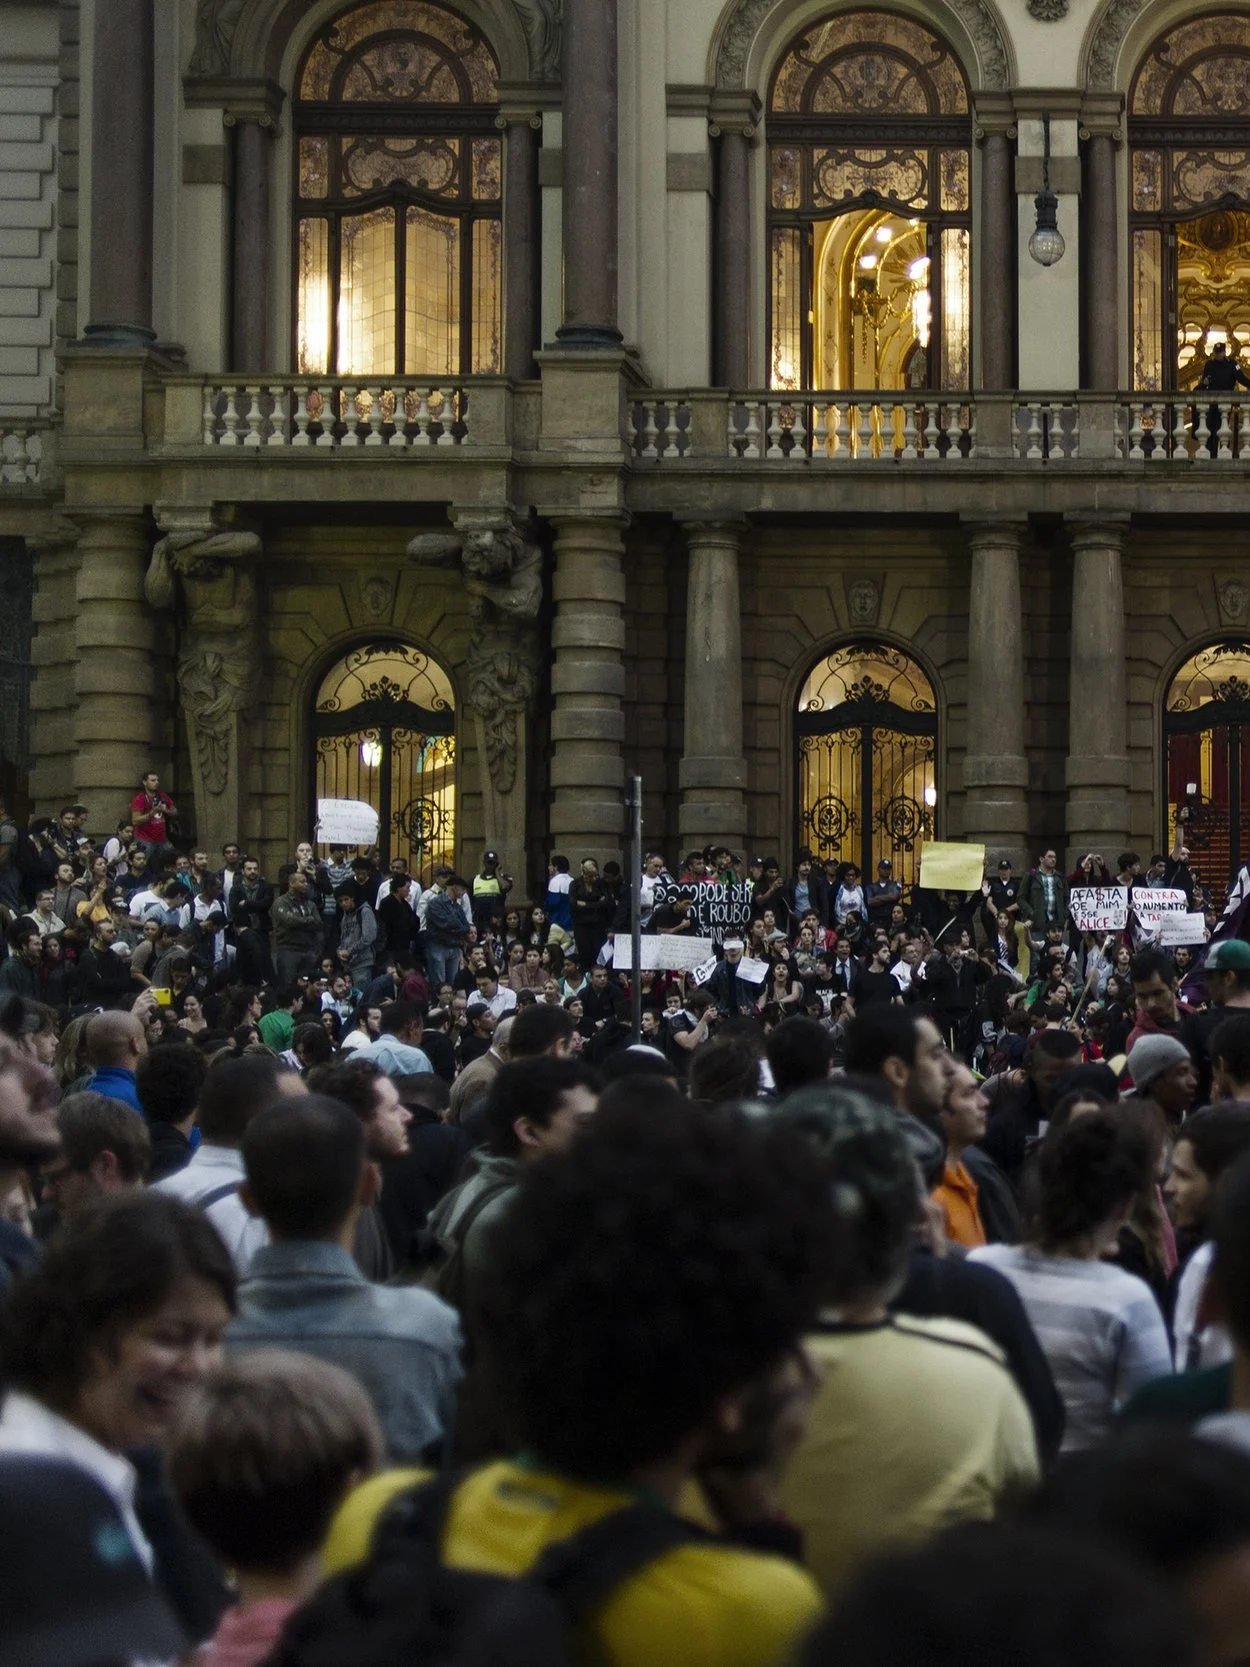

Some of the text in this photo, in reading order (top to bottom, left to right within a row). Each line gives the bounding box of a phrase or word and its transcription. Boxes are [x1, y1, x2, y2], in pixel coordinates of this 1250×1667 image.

[700, 882, 728, 902] PODE
[1134, 890, 1179, 900] CONTRA
[1072, 900, 1120, 911] DE MIM
[1143, 902, 1186, 911] AUMENTO
[710, 903, 751, 923] ROUBO
